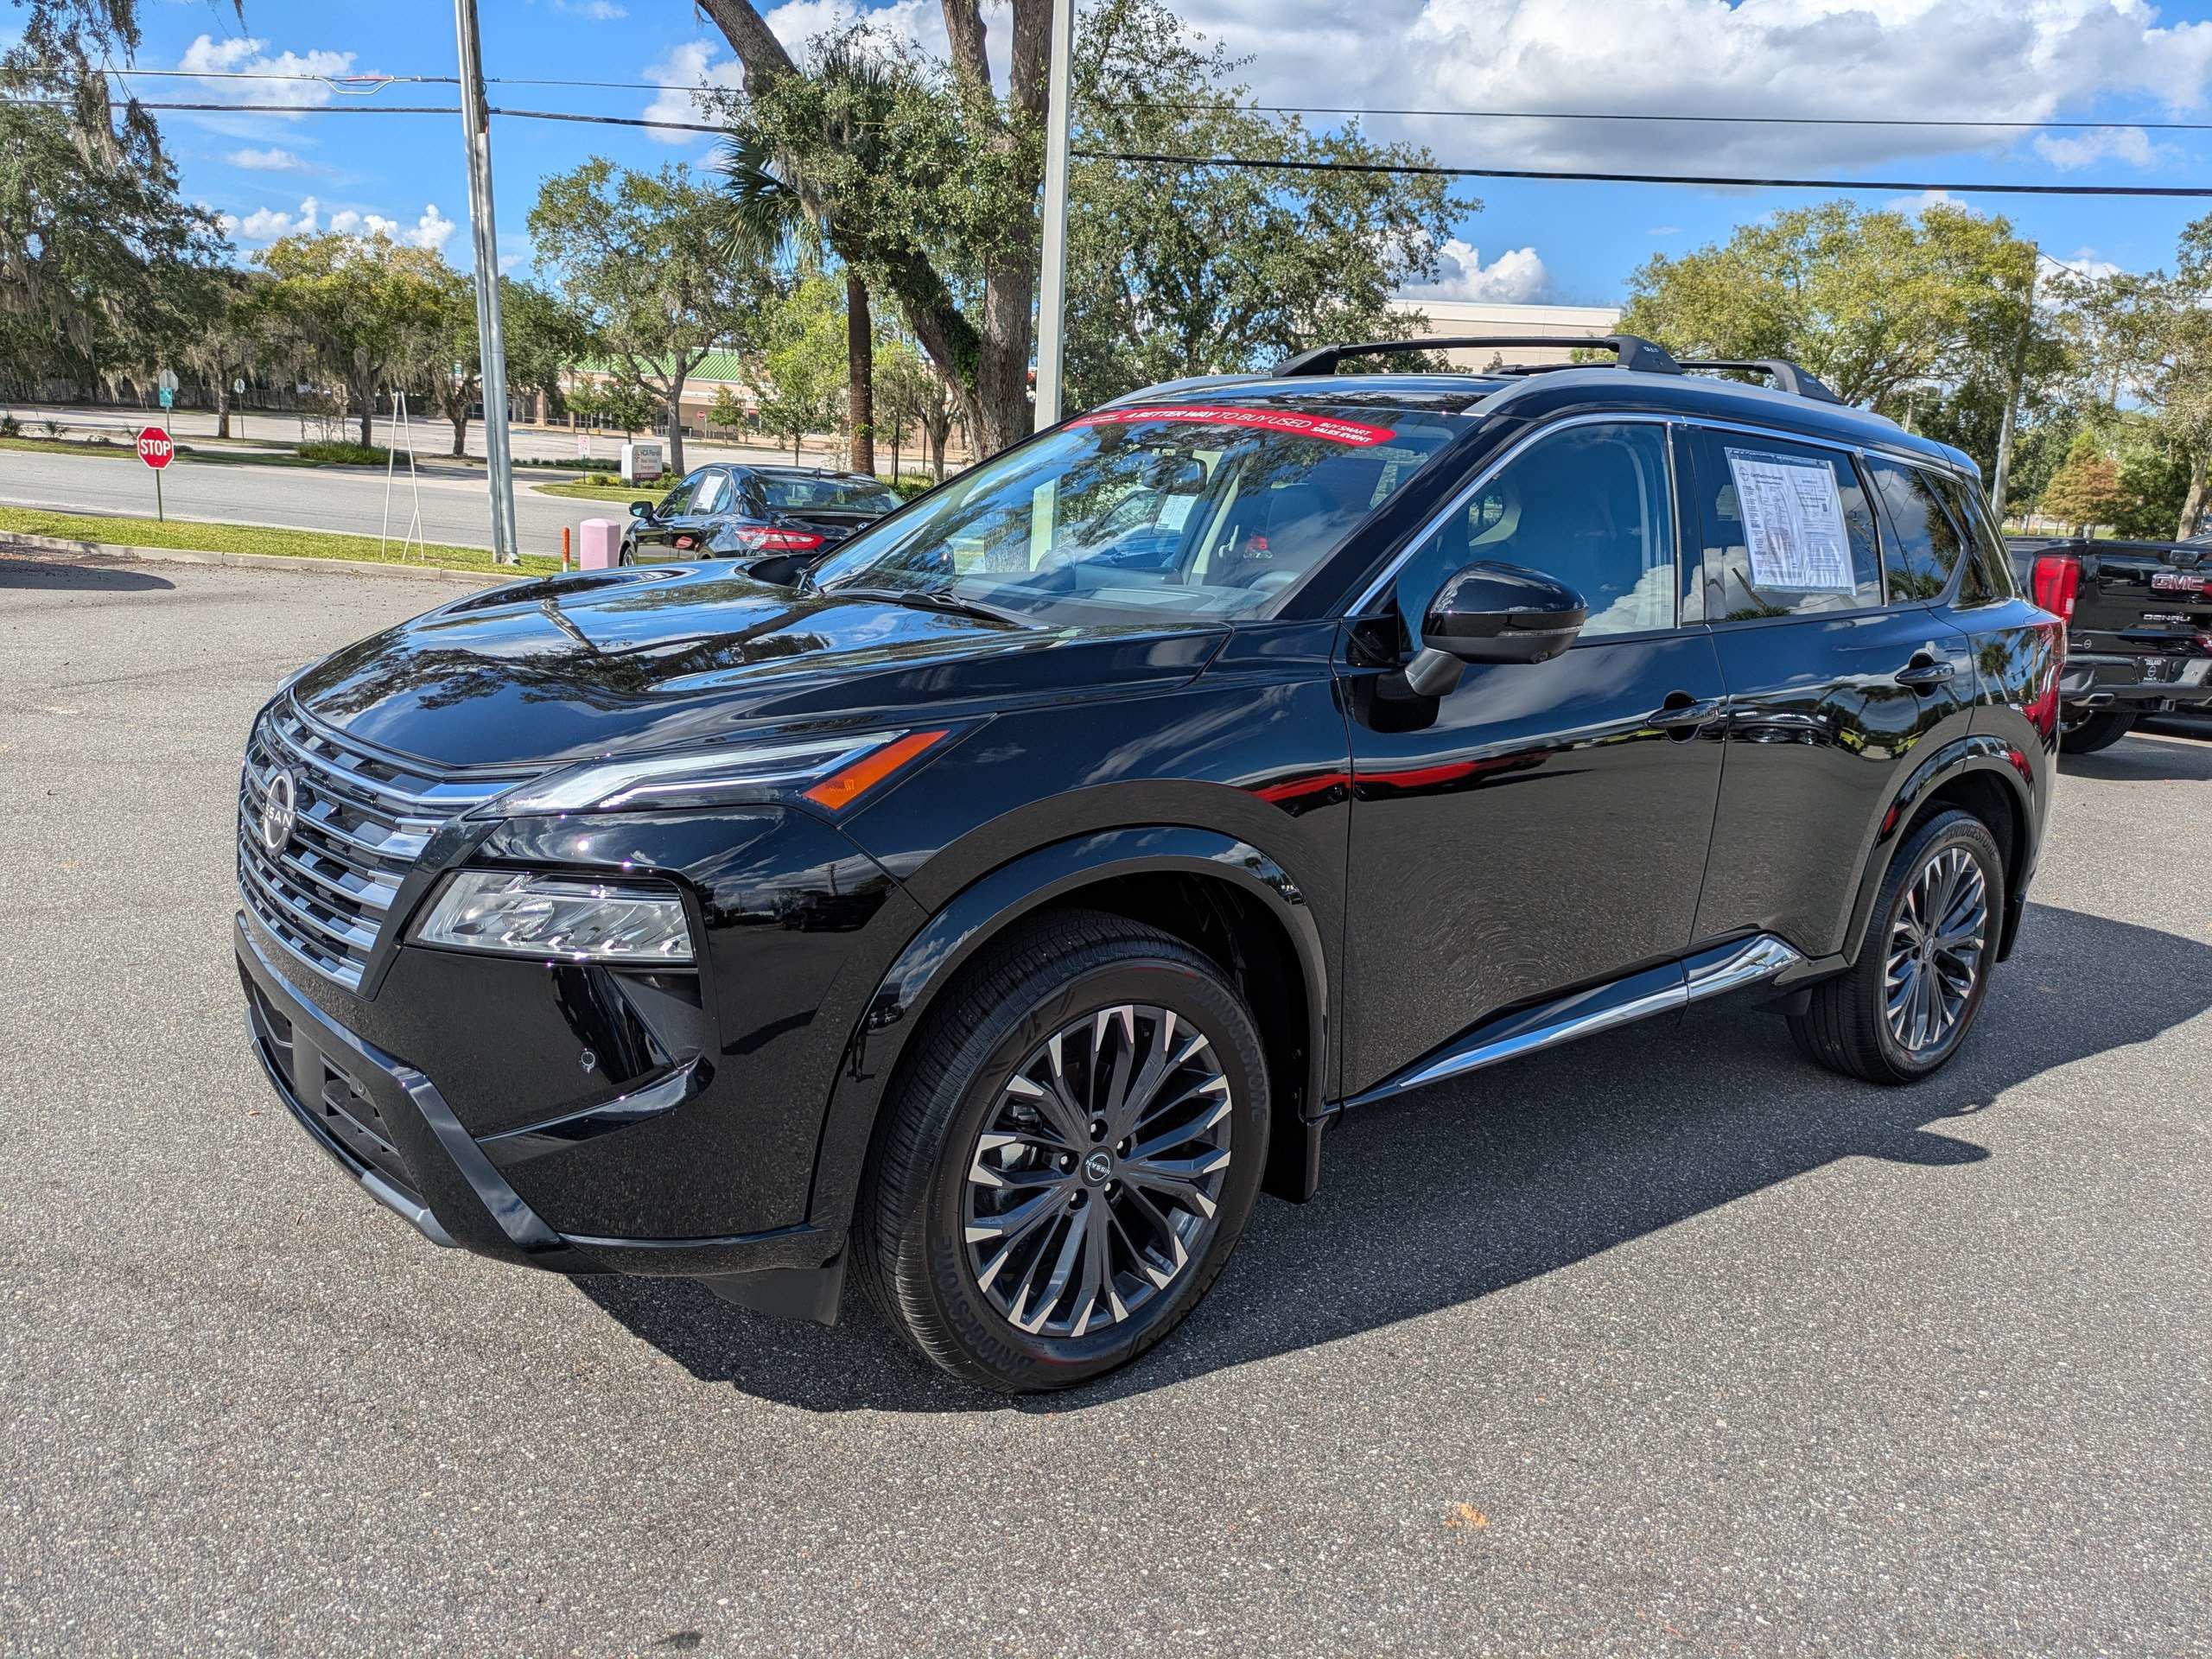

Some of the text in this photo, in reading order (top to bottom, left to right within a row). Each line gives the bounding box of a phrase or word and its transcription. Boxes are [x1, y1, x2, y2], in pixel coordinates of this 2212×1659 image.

[1185, 410, 1219, 419] WAY
[1217, 411, 1238, 420] TO
[1236, 413, 1270, 423] BUY
[1268, 416, 1313, 429] USED
[1311, 426, 1373, 443] SALES EVENT
[1319, 422, 1372, 435] BUY SMART
[140, 439, 171, 456] STOP
[2152, 574, 2205, 591] GMC
[265, 804, 293, 827] SSAN
